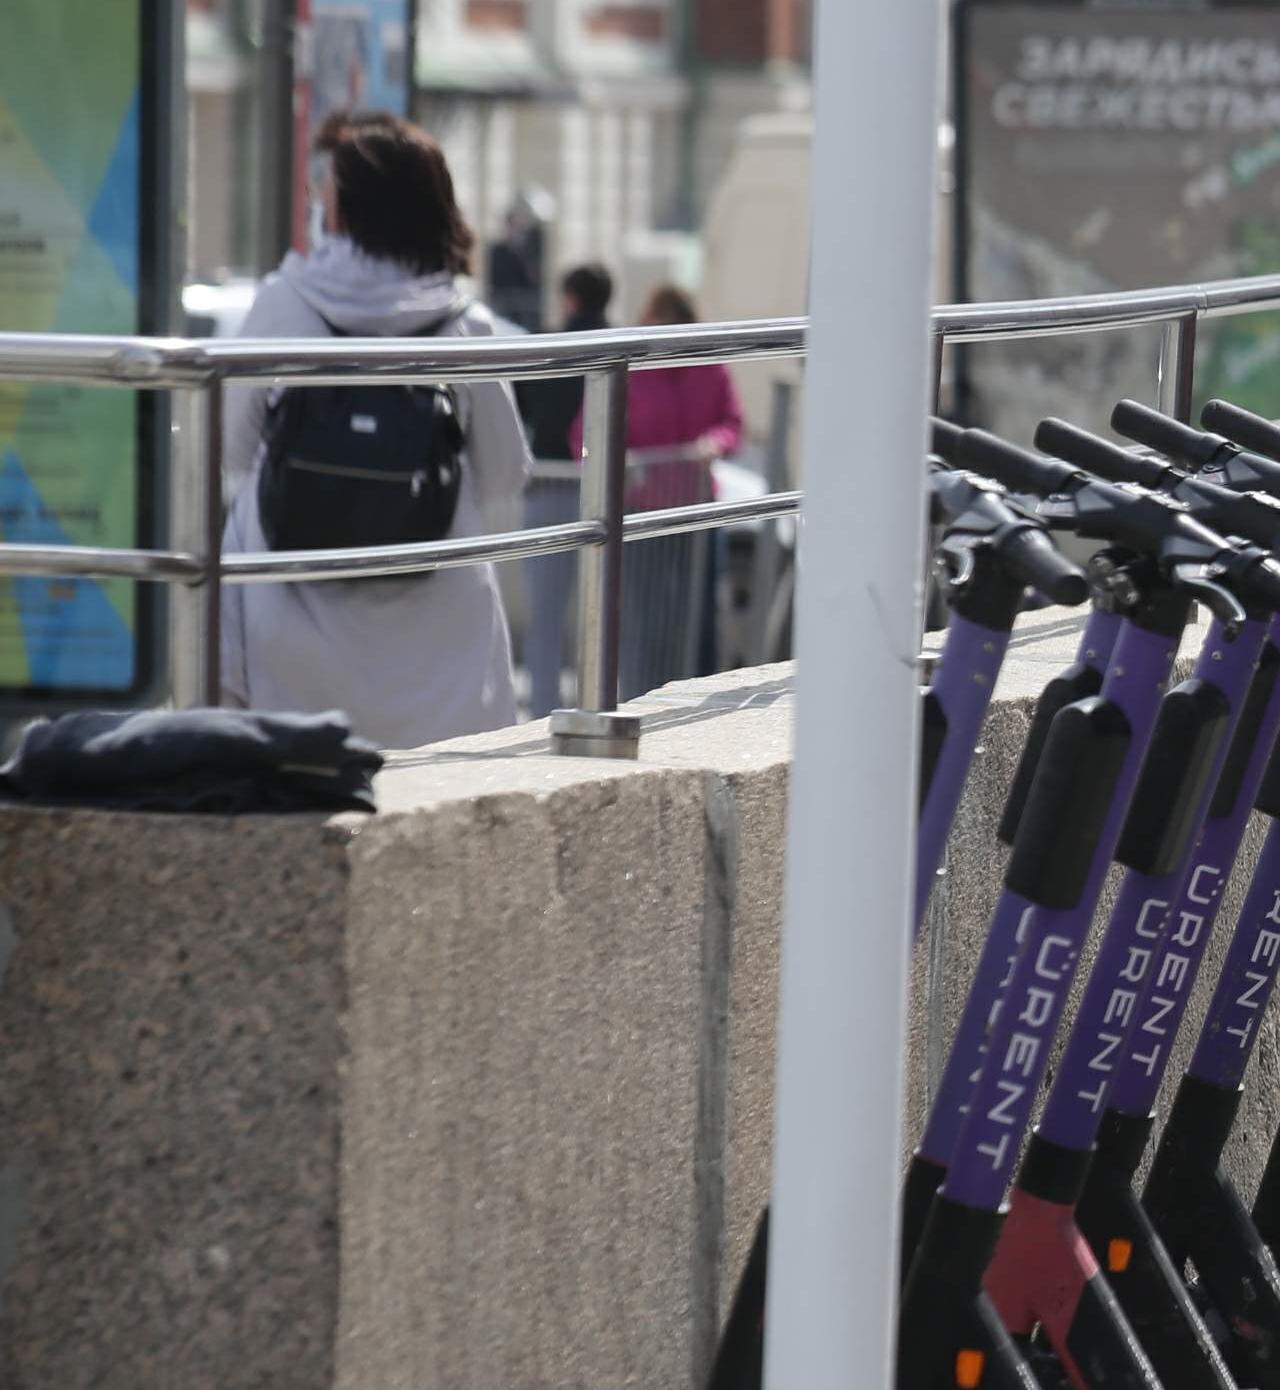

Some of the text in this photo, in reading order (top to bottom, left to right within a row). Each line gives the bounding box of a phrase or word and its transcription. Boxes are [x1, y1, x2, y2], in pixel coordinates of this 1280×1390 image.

[977, 935, 1076, 1171] ÜRENT
[1077, 898, 1171, 1113] ÜRENT
[1131, 864, 1225, 1077] ÜRENT
